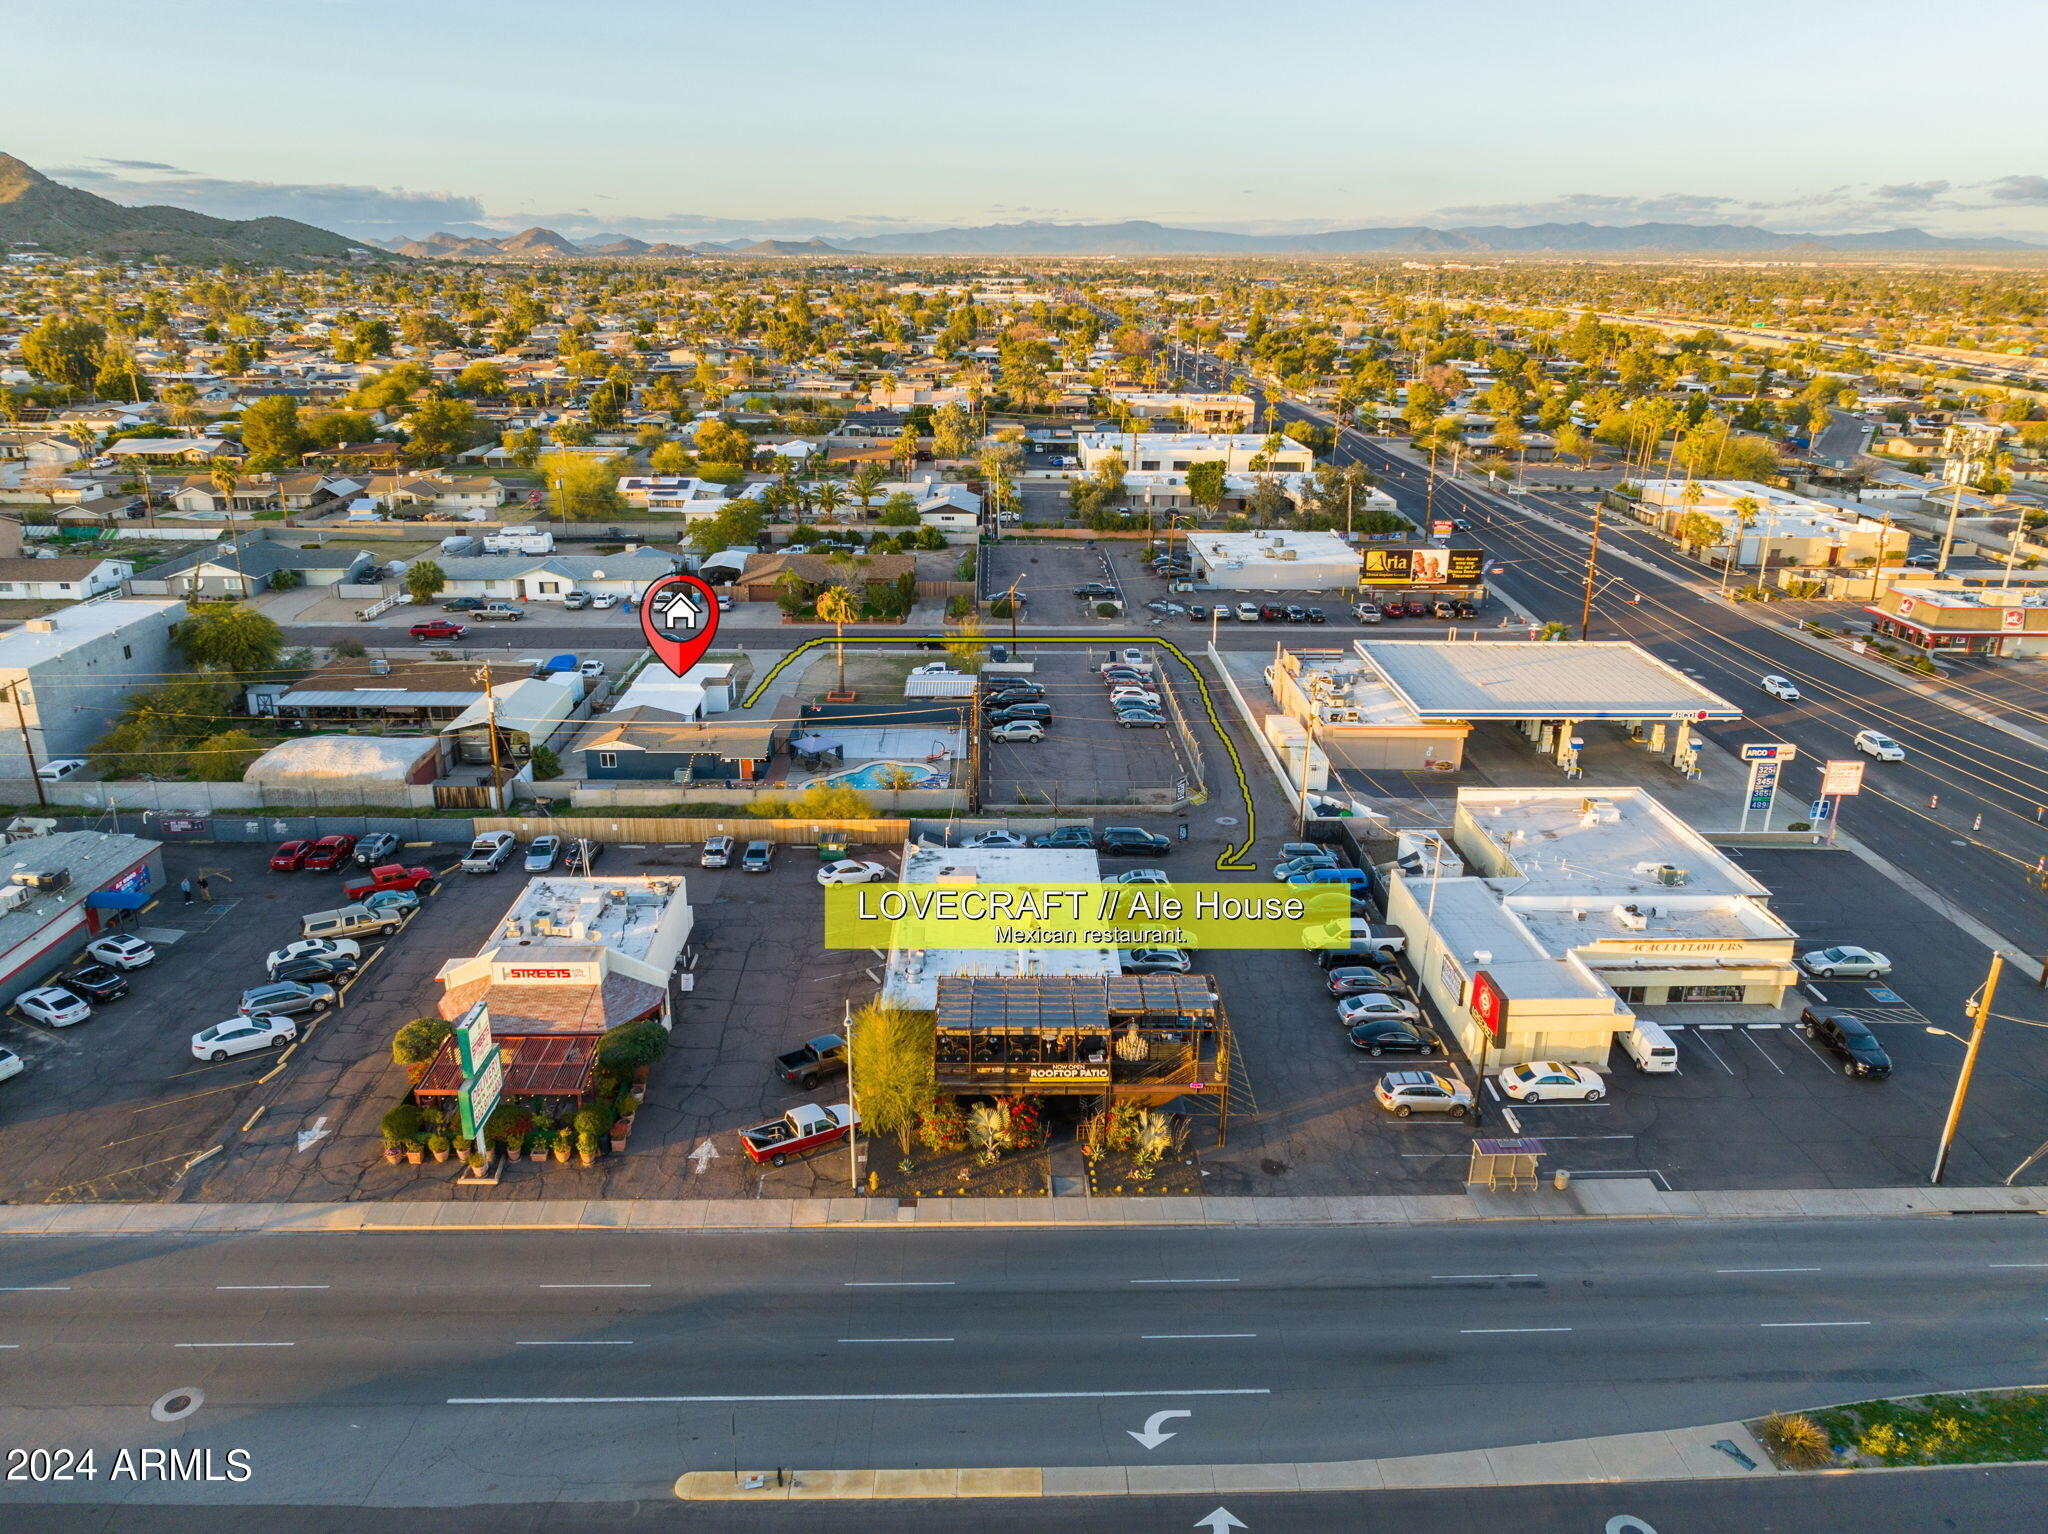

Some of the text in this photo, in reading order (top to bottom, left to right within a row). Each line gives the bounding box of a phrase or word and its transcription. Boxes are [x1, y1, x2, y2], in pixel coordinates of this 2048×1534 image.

[1367, 552, 1407, 572] Aria
[1746, 749, 1769, 757] ARCO
[1631, 943, 1744, 952] ACACIA FLOWERS
[511, 968, 571, 978] STREETS
[1030, 1069, 1079, 1078] ROOFTOP
[1080, 1069, 1108, 1077] PATIO
